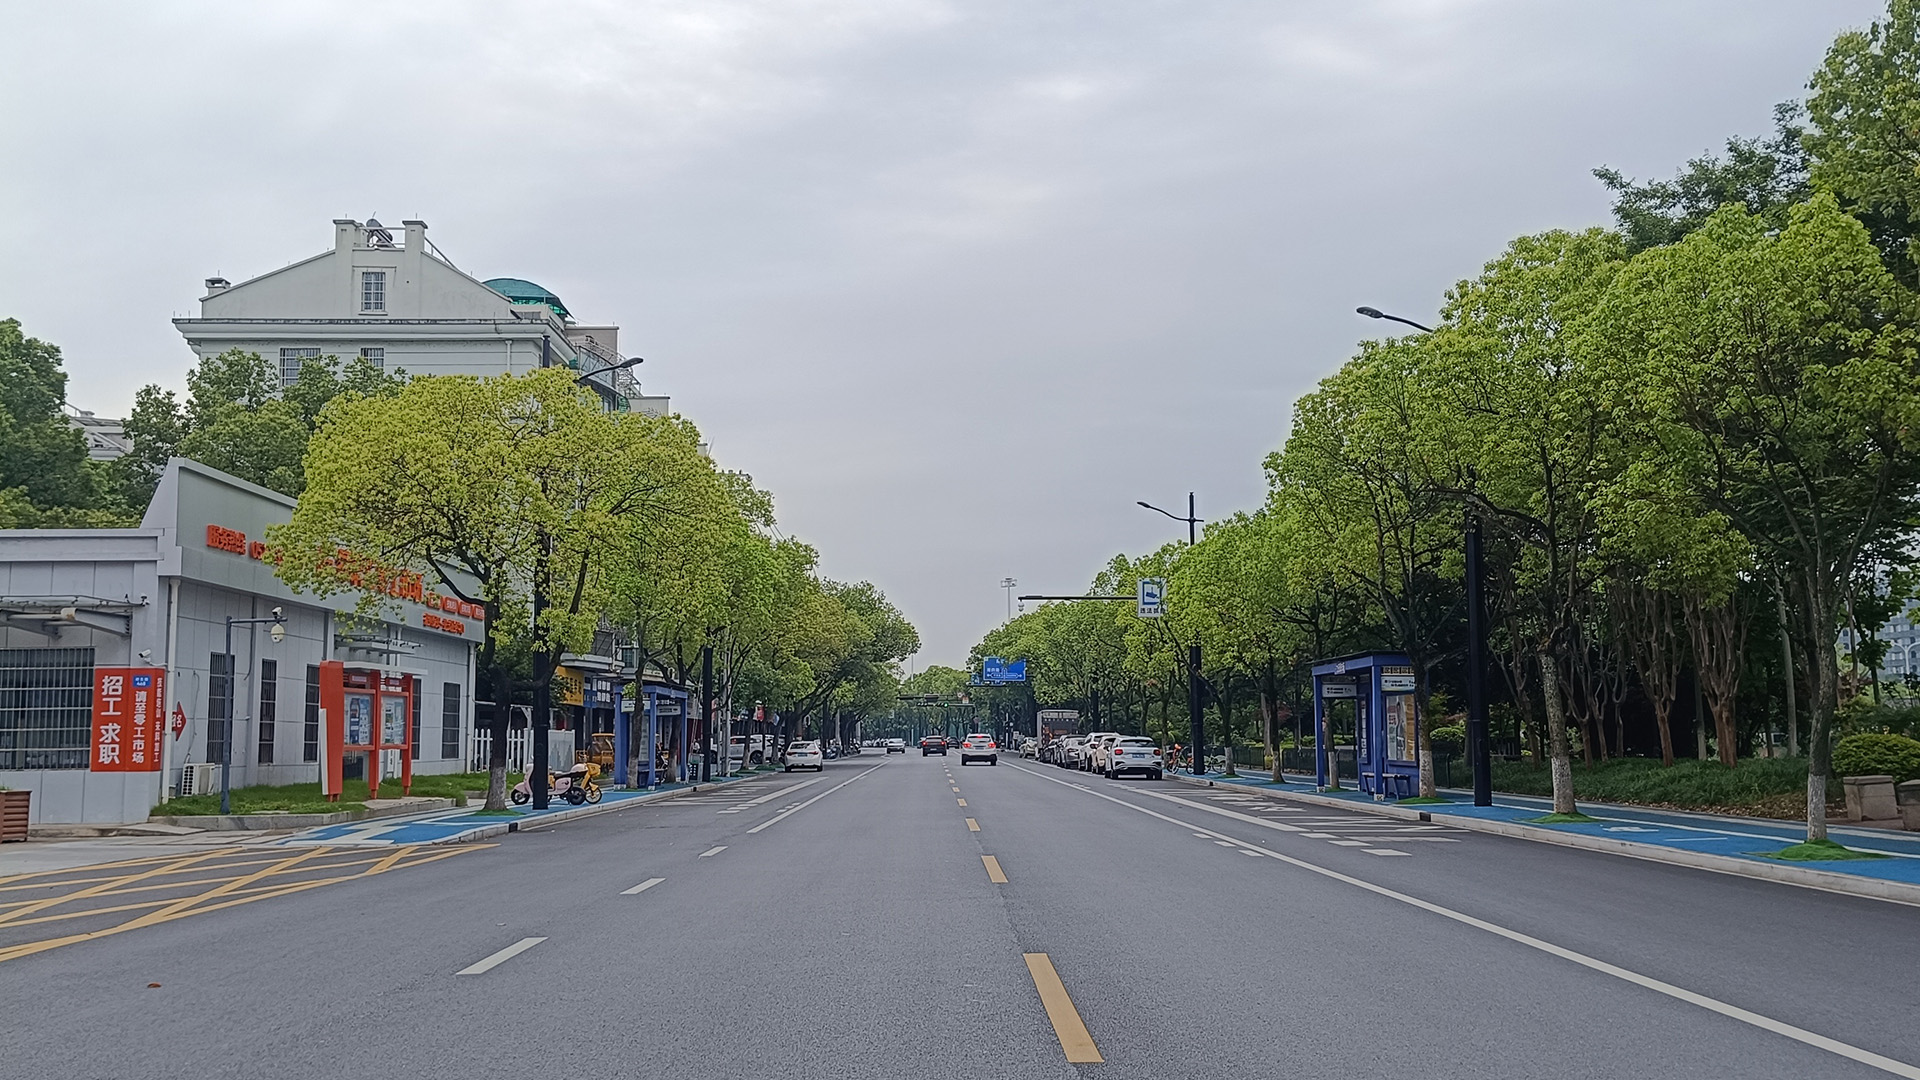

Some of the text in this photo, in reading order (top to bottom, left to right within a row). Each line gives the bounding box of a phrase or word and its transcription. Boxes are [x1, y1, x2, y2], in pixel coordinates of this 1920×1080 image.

[98, 675, 124, 764] 招工 求职
[132, 690, 147, 764] 请至零工市场
